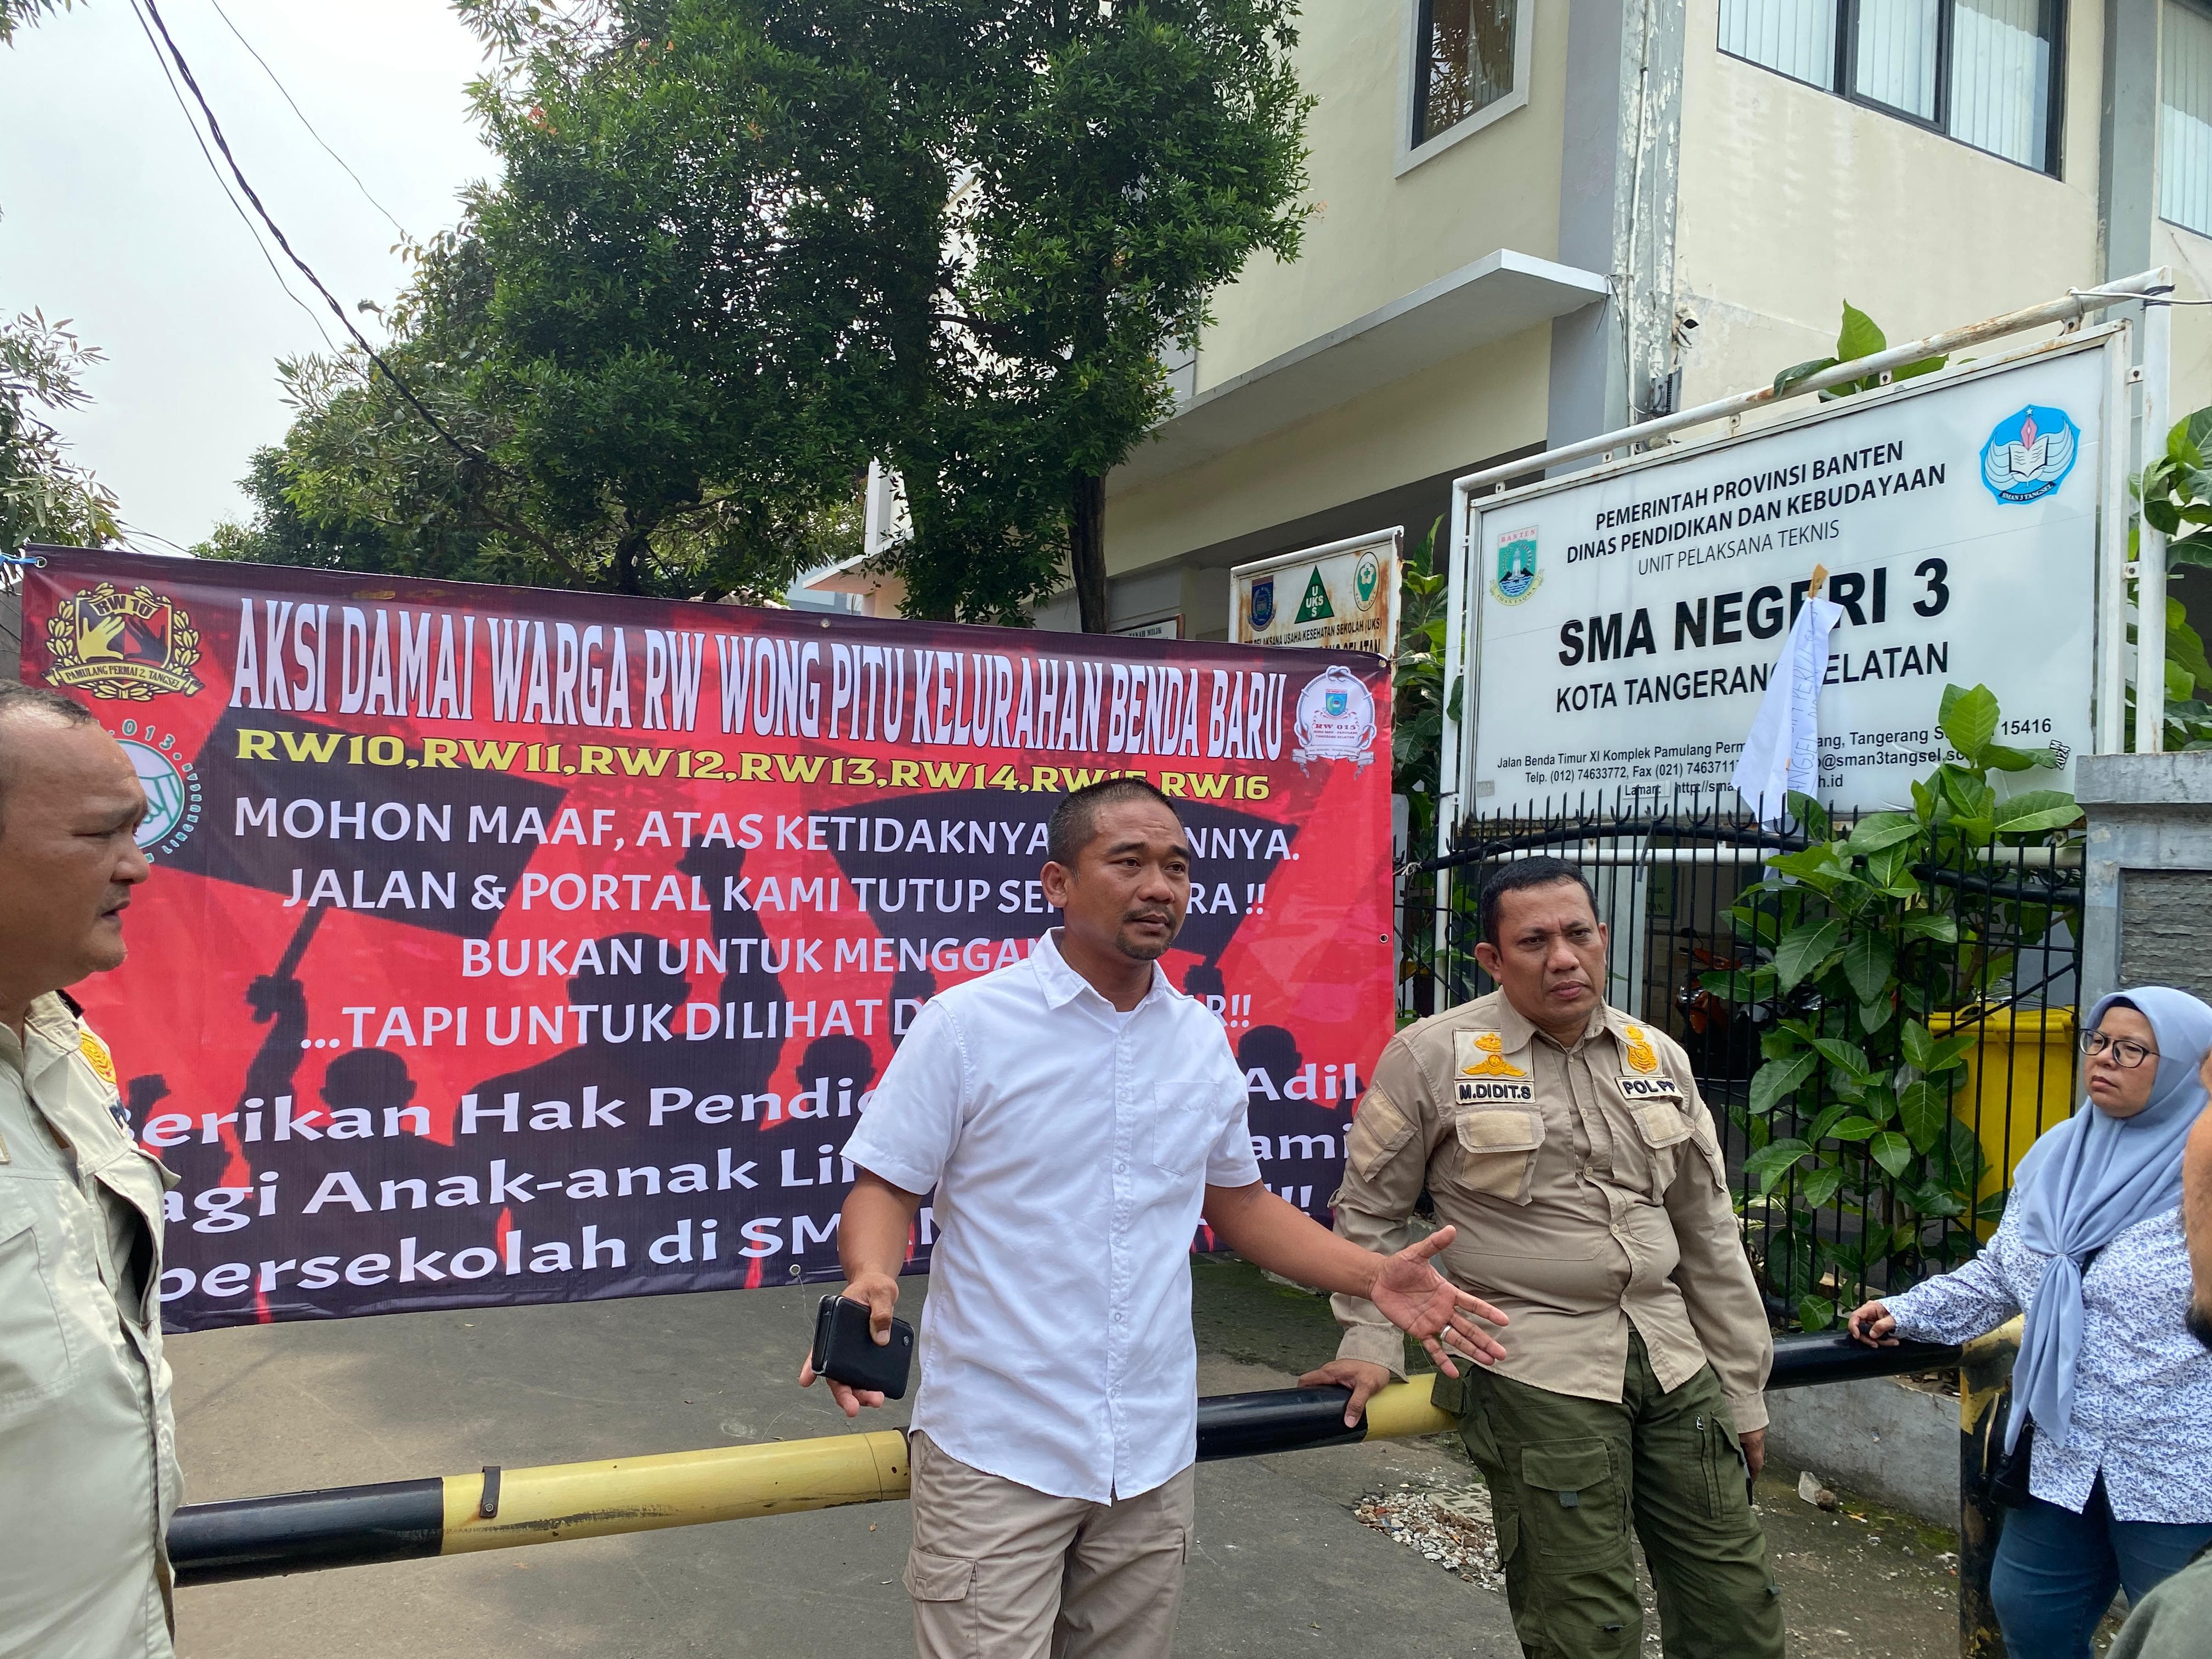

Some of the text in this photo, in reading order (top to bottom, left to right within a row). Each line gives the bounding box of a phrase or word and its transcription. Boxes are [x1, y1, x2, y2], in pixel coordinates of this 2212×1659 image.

[1596, 440, 1903, 531] PEMERINTAH PROVINSI BANTEN
[1501, 529, 1536, 543] BANTEN
[1567, 463, 1946, 564] DINAS PENDIDIKAN DAN KEBUDAYAAN
[1638, 519, 1839, 575] UNIT PELAKSANA TEKNIS
[95, 595, 126, 616] RW
[1558, 607, 1656, 667] SMA
[1912, 557, 1950, 617] 3
[1147, 627, 1162, 636] MILIK
[1284, 631, 1301, 645] USAHA
[1302, 625, 1335, 641] KESEHATAN
[1336, 619, 1364, 635] SEKOLAH
[1365, 616, 1382, 634] (UKS)
[65, 665, 108, 681] PAMULANG
[109, 665, 138, 677] PERMAI
[149, 669, 181, 690] TANGSEL
[229, 598, 1288, 762] AKSI DAMAI WARGA RW WONG PITU KELURAHAN BENDA BARU
[1556, 641, 1949, 713] KOTA TANGERAN ELATAN
[1497, 756, 1522, 769] Jalan
[1525, 753, 1555, 766] Benda
[1559, 752, 1587, 765] Timur
[1590, 751, 1600, 763] XI
[1603, 746, 1651, 763] Komplek
[1655, 743, 1712, 759] Pamulang
[1716, 742, 1746, 754] Perm
[1850, 729, 1928, 747] Tangerang
[2001, 718, 2052, 736] 15416
[1525, 771, 1547, 783] Telp.
[1550, 769, 1575, 783] (012)
[1578, 766, 1629, 780] 74633772,
[1633, 765, 1652, 777] Fax
[1655, 763, 1683, 779] (021)
[1687, 759, 1739, 774] 7463711
[235, 797, 451, 841] MOHON
[467, 805, 625, 852] MAAF,
[636, 810, 764, 850] ATAS
[283, 868, 456, 909] JALAN
[471, 875, 506, 911] &
[521, 873, 712, 912] PORTAL
[723, 875, 839, 912] KAMI
[850, 877, 990, 913] TUTUP
[462, 938, 1042, 977] BUKAN UNTUK MENGGA
[486, 1003, 673, 1044] UNTUK
[686, 999, 882, 1042] DILIHAT
[125, 1095, 430, 1147] erikan
[460, 1085, 626, 1134] Hak
[1245, 1063, 1357, 1102] Adil
[1459, 1084, 1531, 1100] M.DIDIT.S
[1622, 1079, 1658, 1094] POL
[302, 1148, 758, 1214] Anak-anak
[648, 1218, 718, 1265] di
